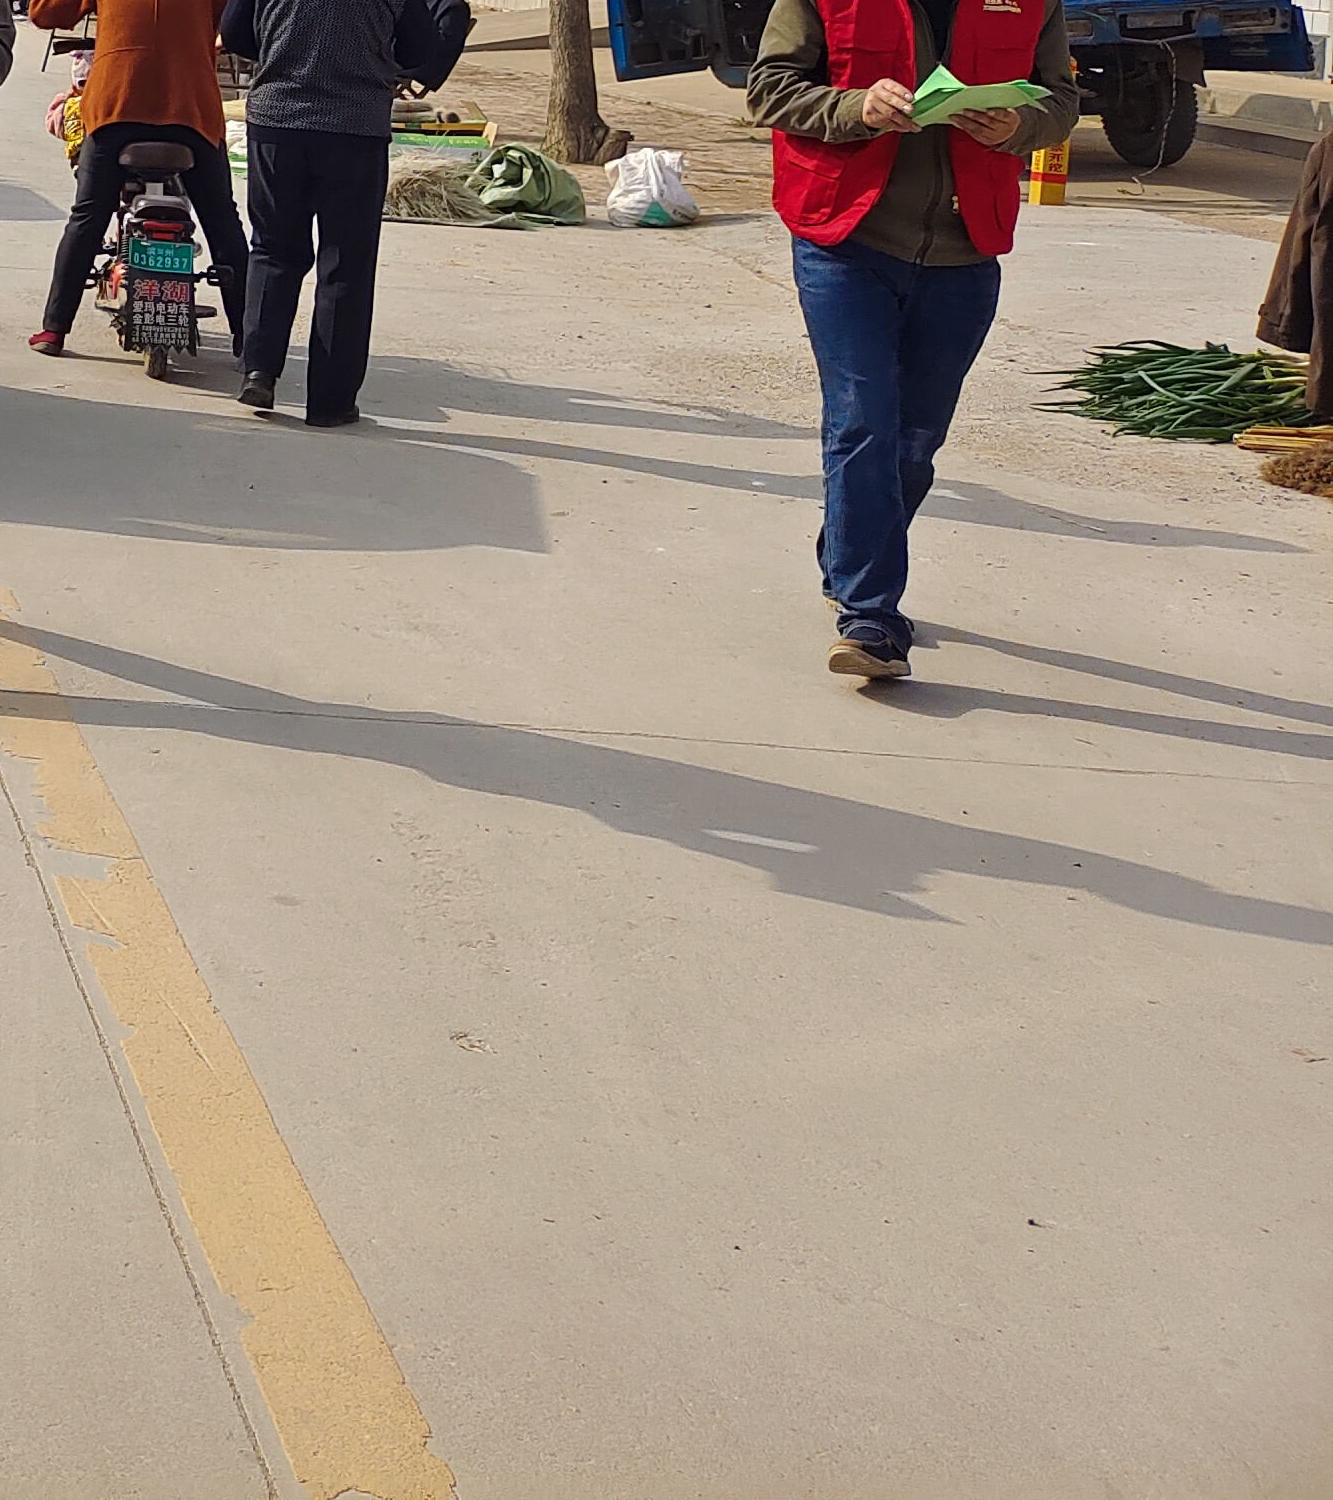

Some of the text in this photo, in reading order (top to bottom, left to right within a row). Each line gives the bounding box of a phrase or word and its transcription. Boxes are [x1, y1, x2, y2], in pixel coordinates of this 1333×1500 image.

[133, 252, 188, 269] 0362937
[133, 279, 190, 303] 洋湖
[133, 301, 190, 315] 爱玛电动车
[132, 313, 190, 327] 金彭电三轮
